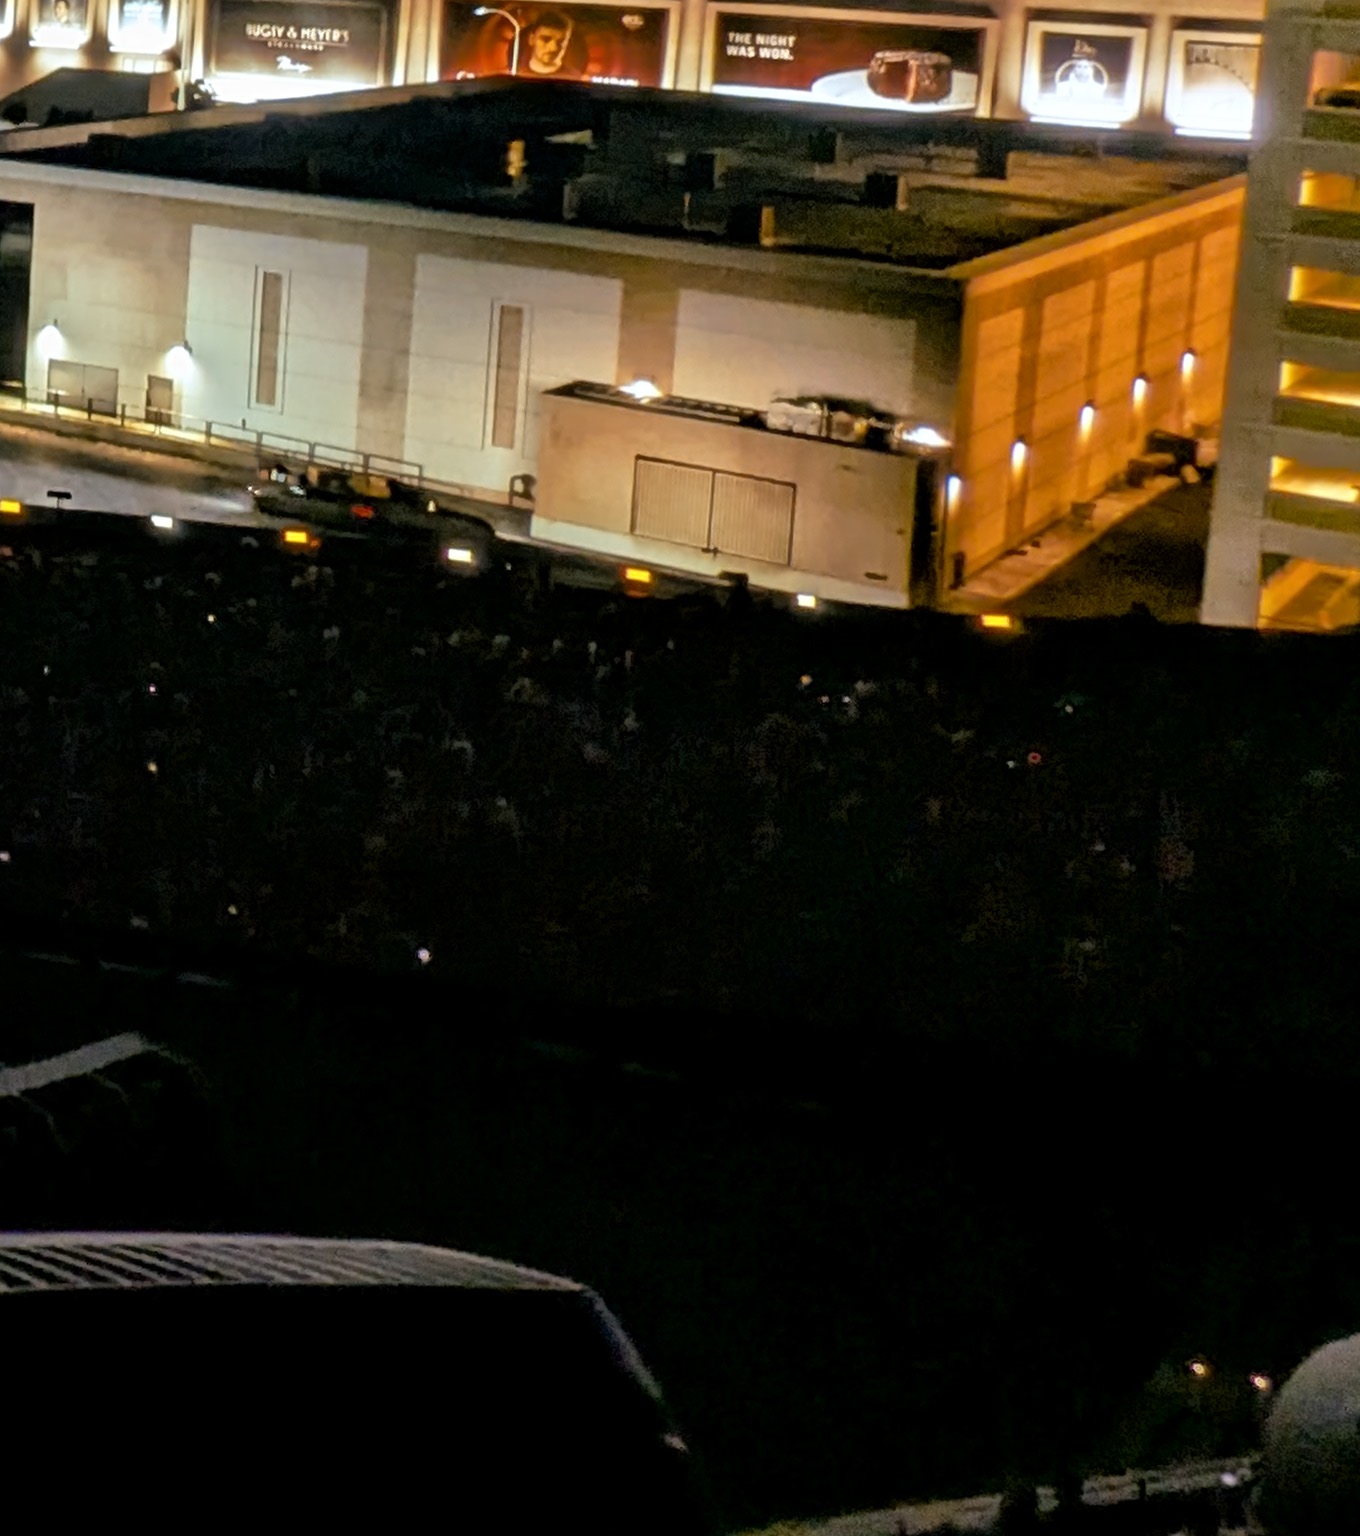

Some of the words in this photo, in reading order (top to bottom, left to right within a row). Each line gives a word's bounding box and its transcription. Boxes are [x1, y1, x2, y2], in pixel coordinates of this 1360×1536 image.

[286, 25, 298, 39] &
[728, 31, 752, 45] THE
[755, 32, 796, 48] NIGHT
[726, 44, 756, 59] WAS
